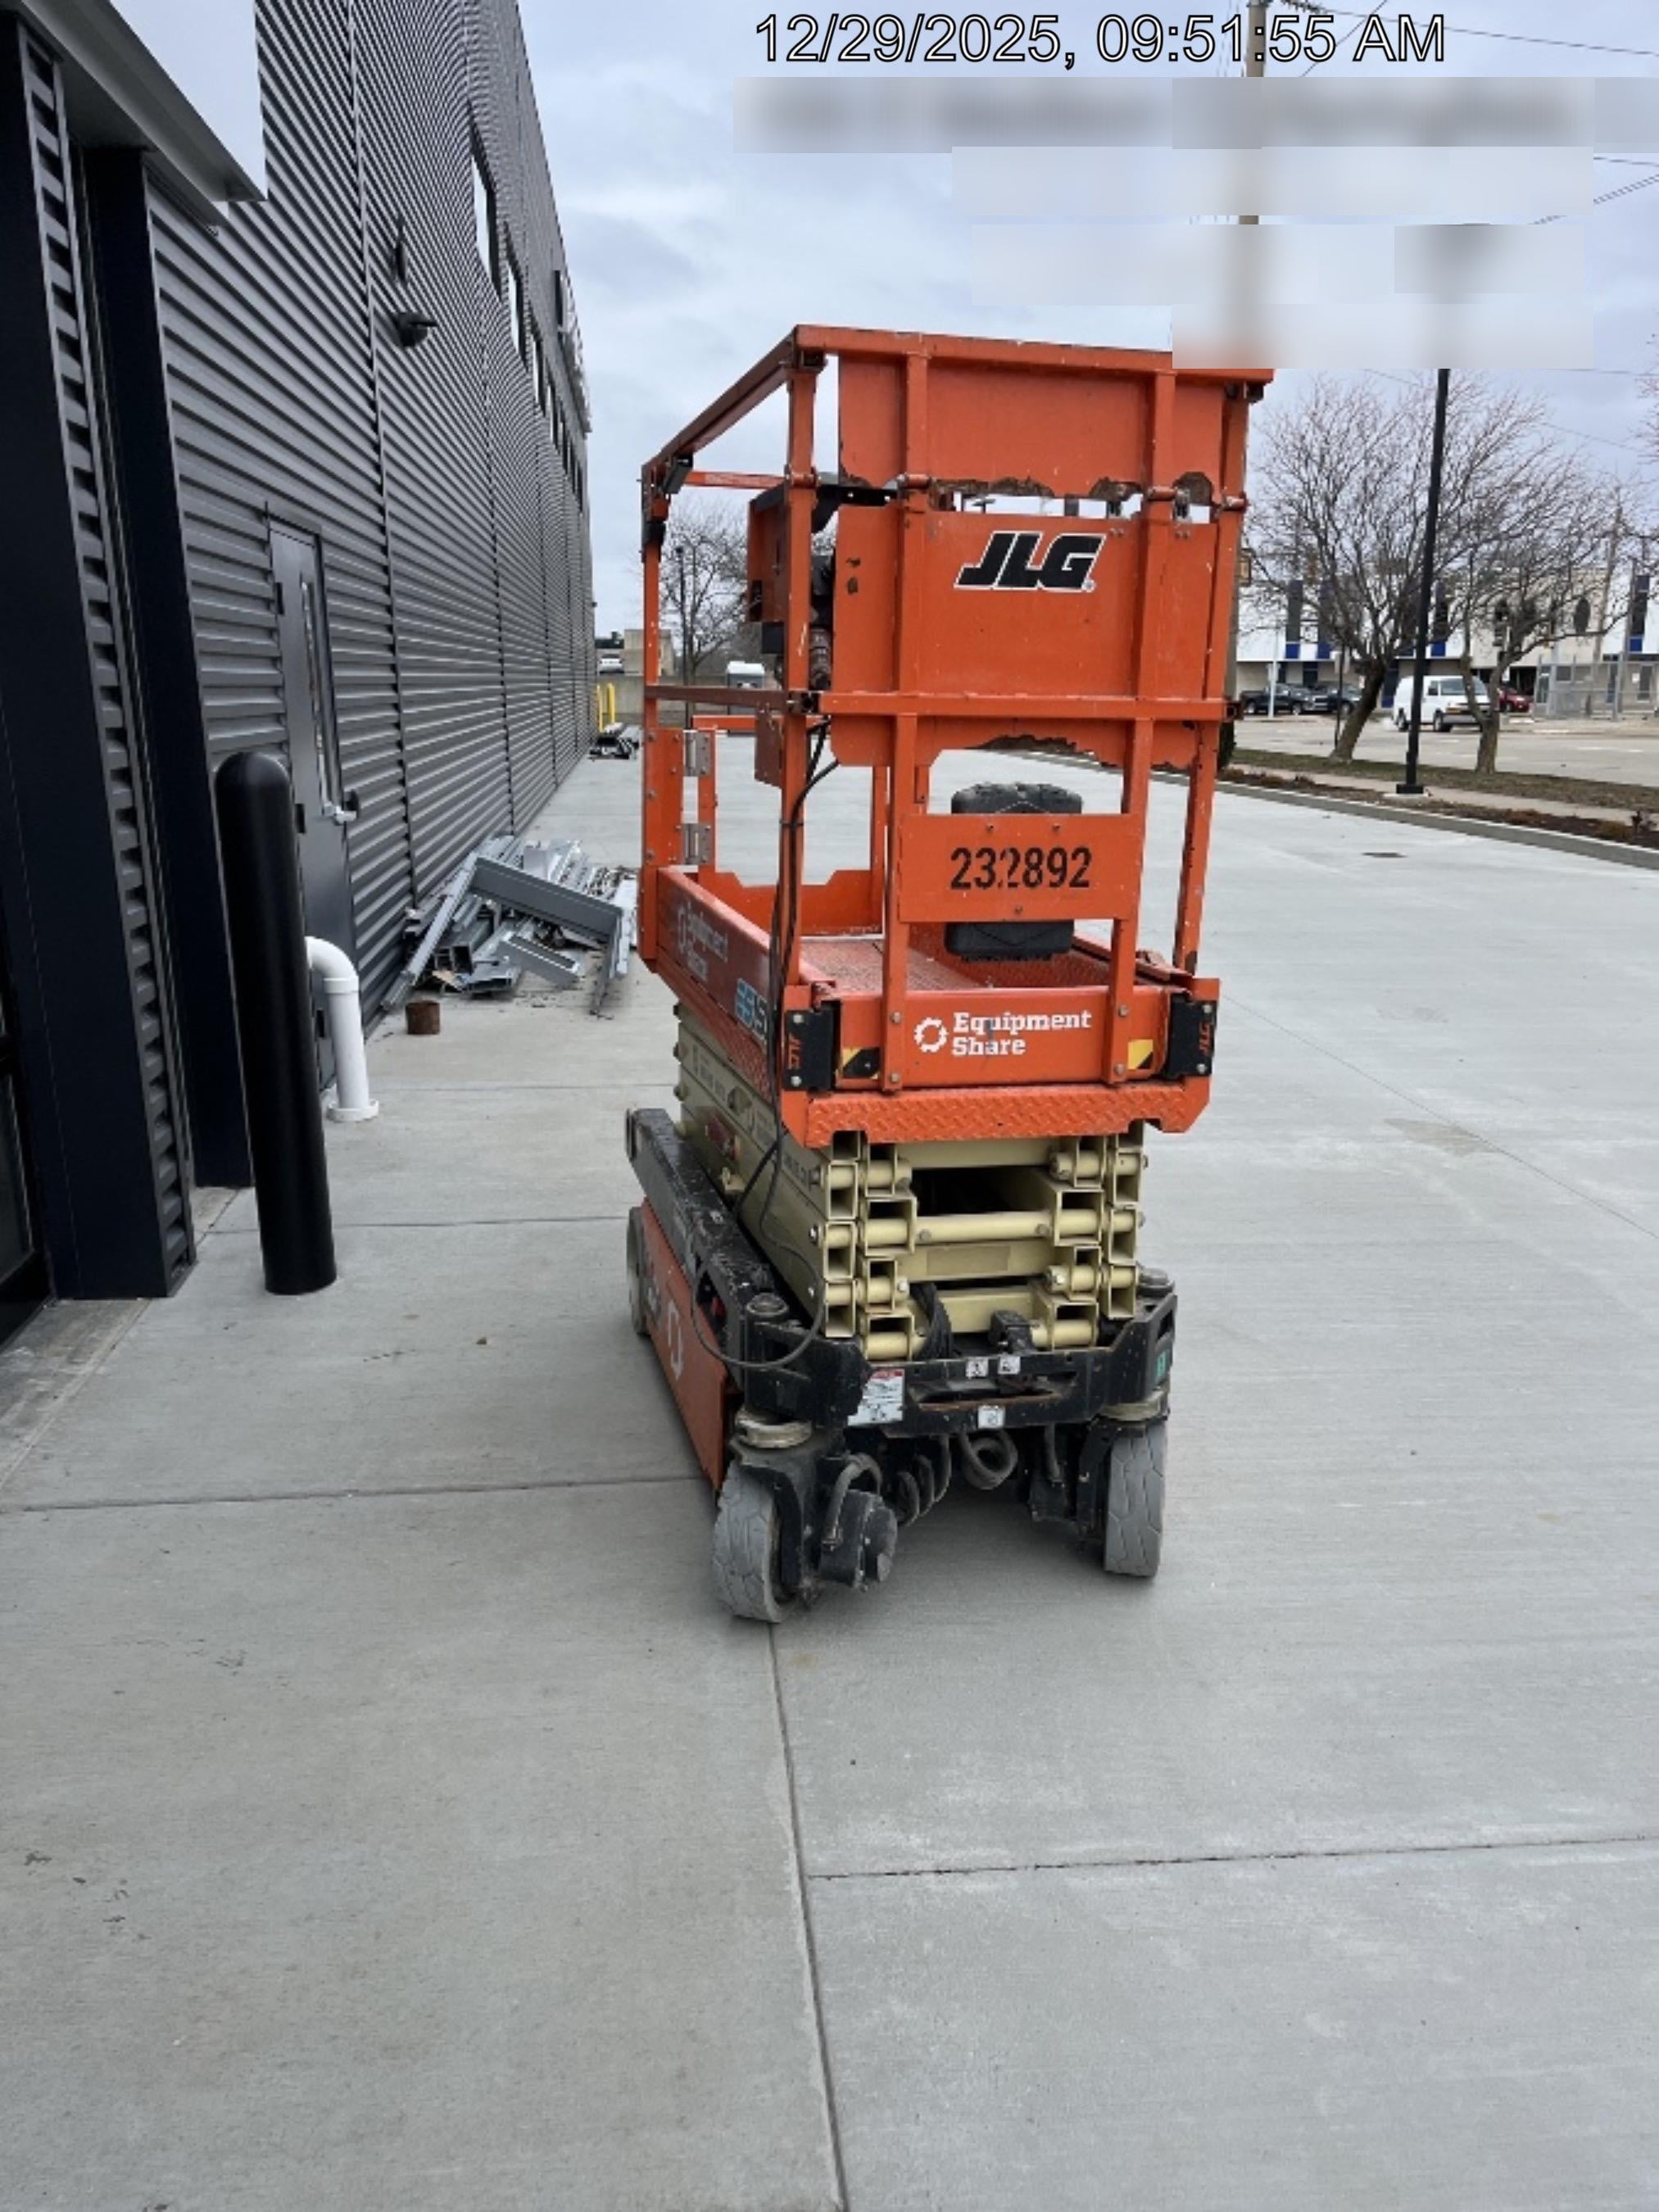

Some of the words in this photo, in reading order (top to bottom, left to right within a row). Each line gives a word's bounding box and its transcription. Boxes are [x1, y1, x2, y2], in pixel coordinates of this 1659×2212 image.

[954, 530, 1107, 592] JLG
[950, 846, 1092, 890] 232892
[953, 1010, 1092, 1036] Equipment
[951, 1036, 1026, 1057] Share
